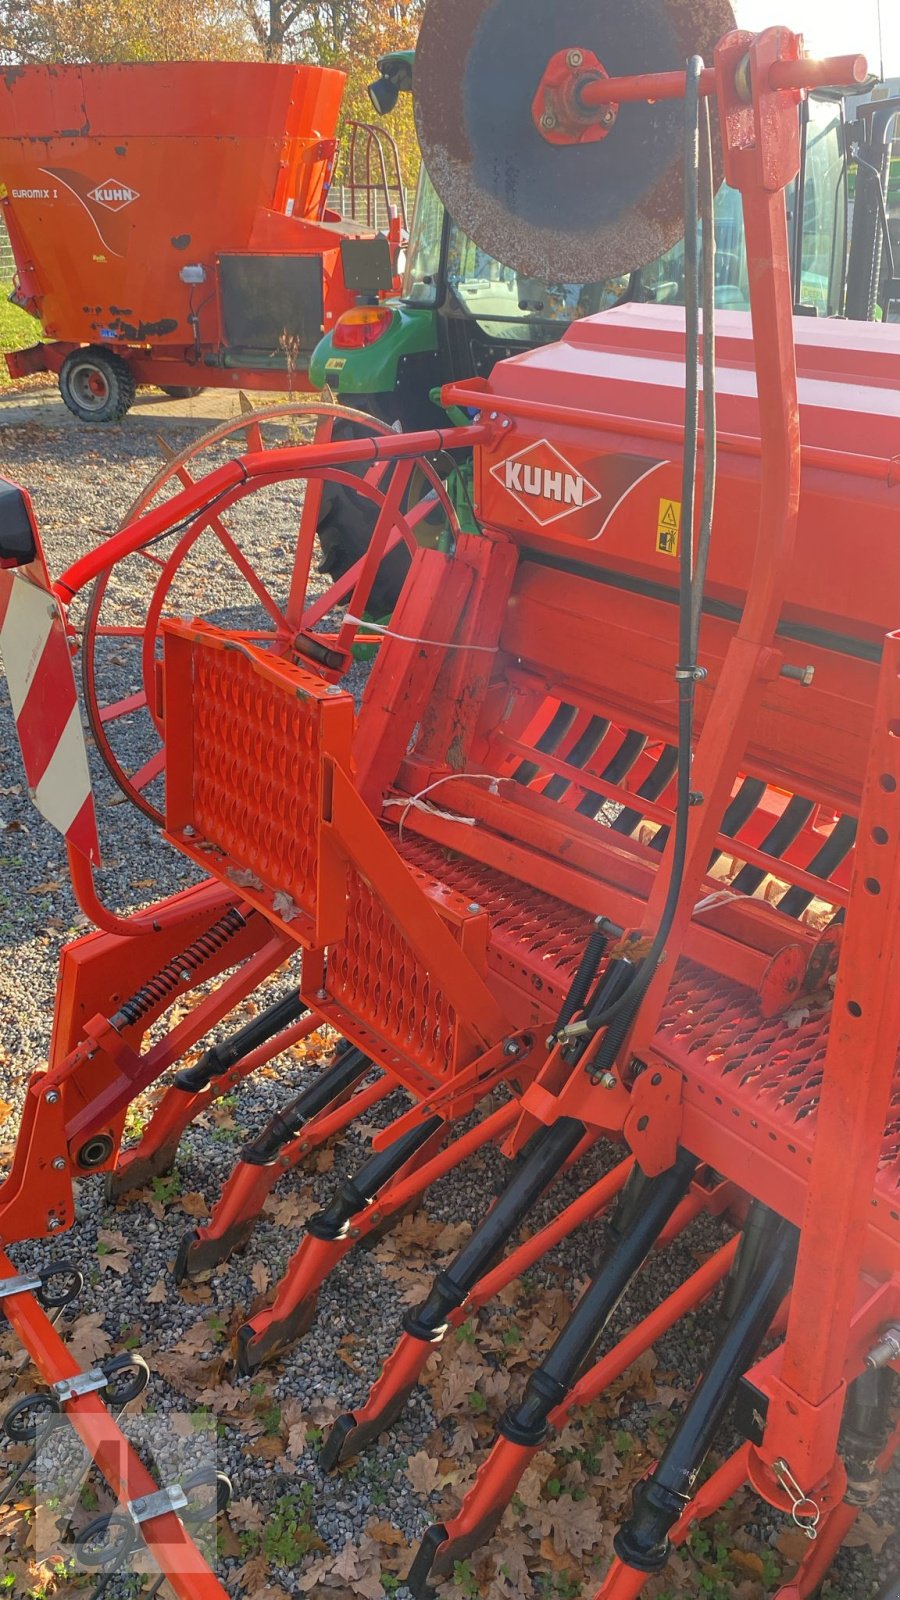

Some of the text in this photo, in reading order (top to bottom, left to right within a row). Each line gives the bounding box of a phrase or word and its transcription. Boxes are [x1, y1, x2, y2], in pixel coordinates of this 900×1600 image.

[12, 189, 49, 199] EUROMIX
[95, 189, 132, 201] KUHN
[505, 460, 584, 507] KUHN
